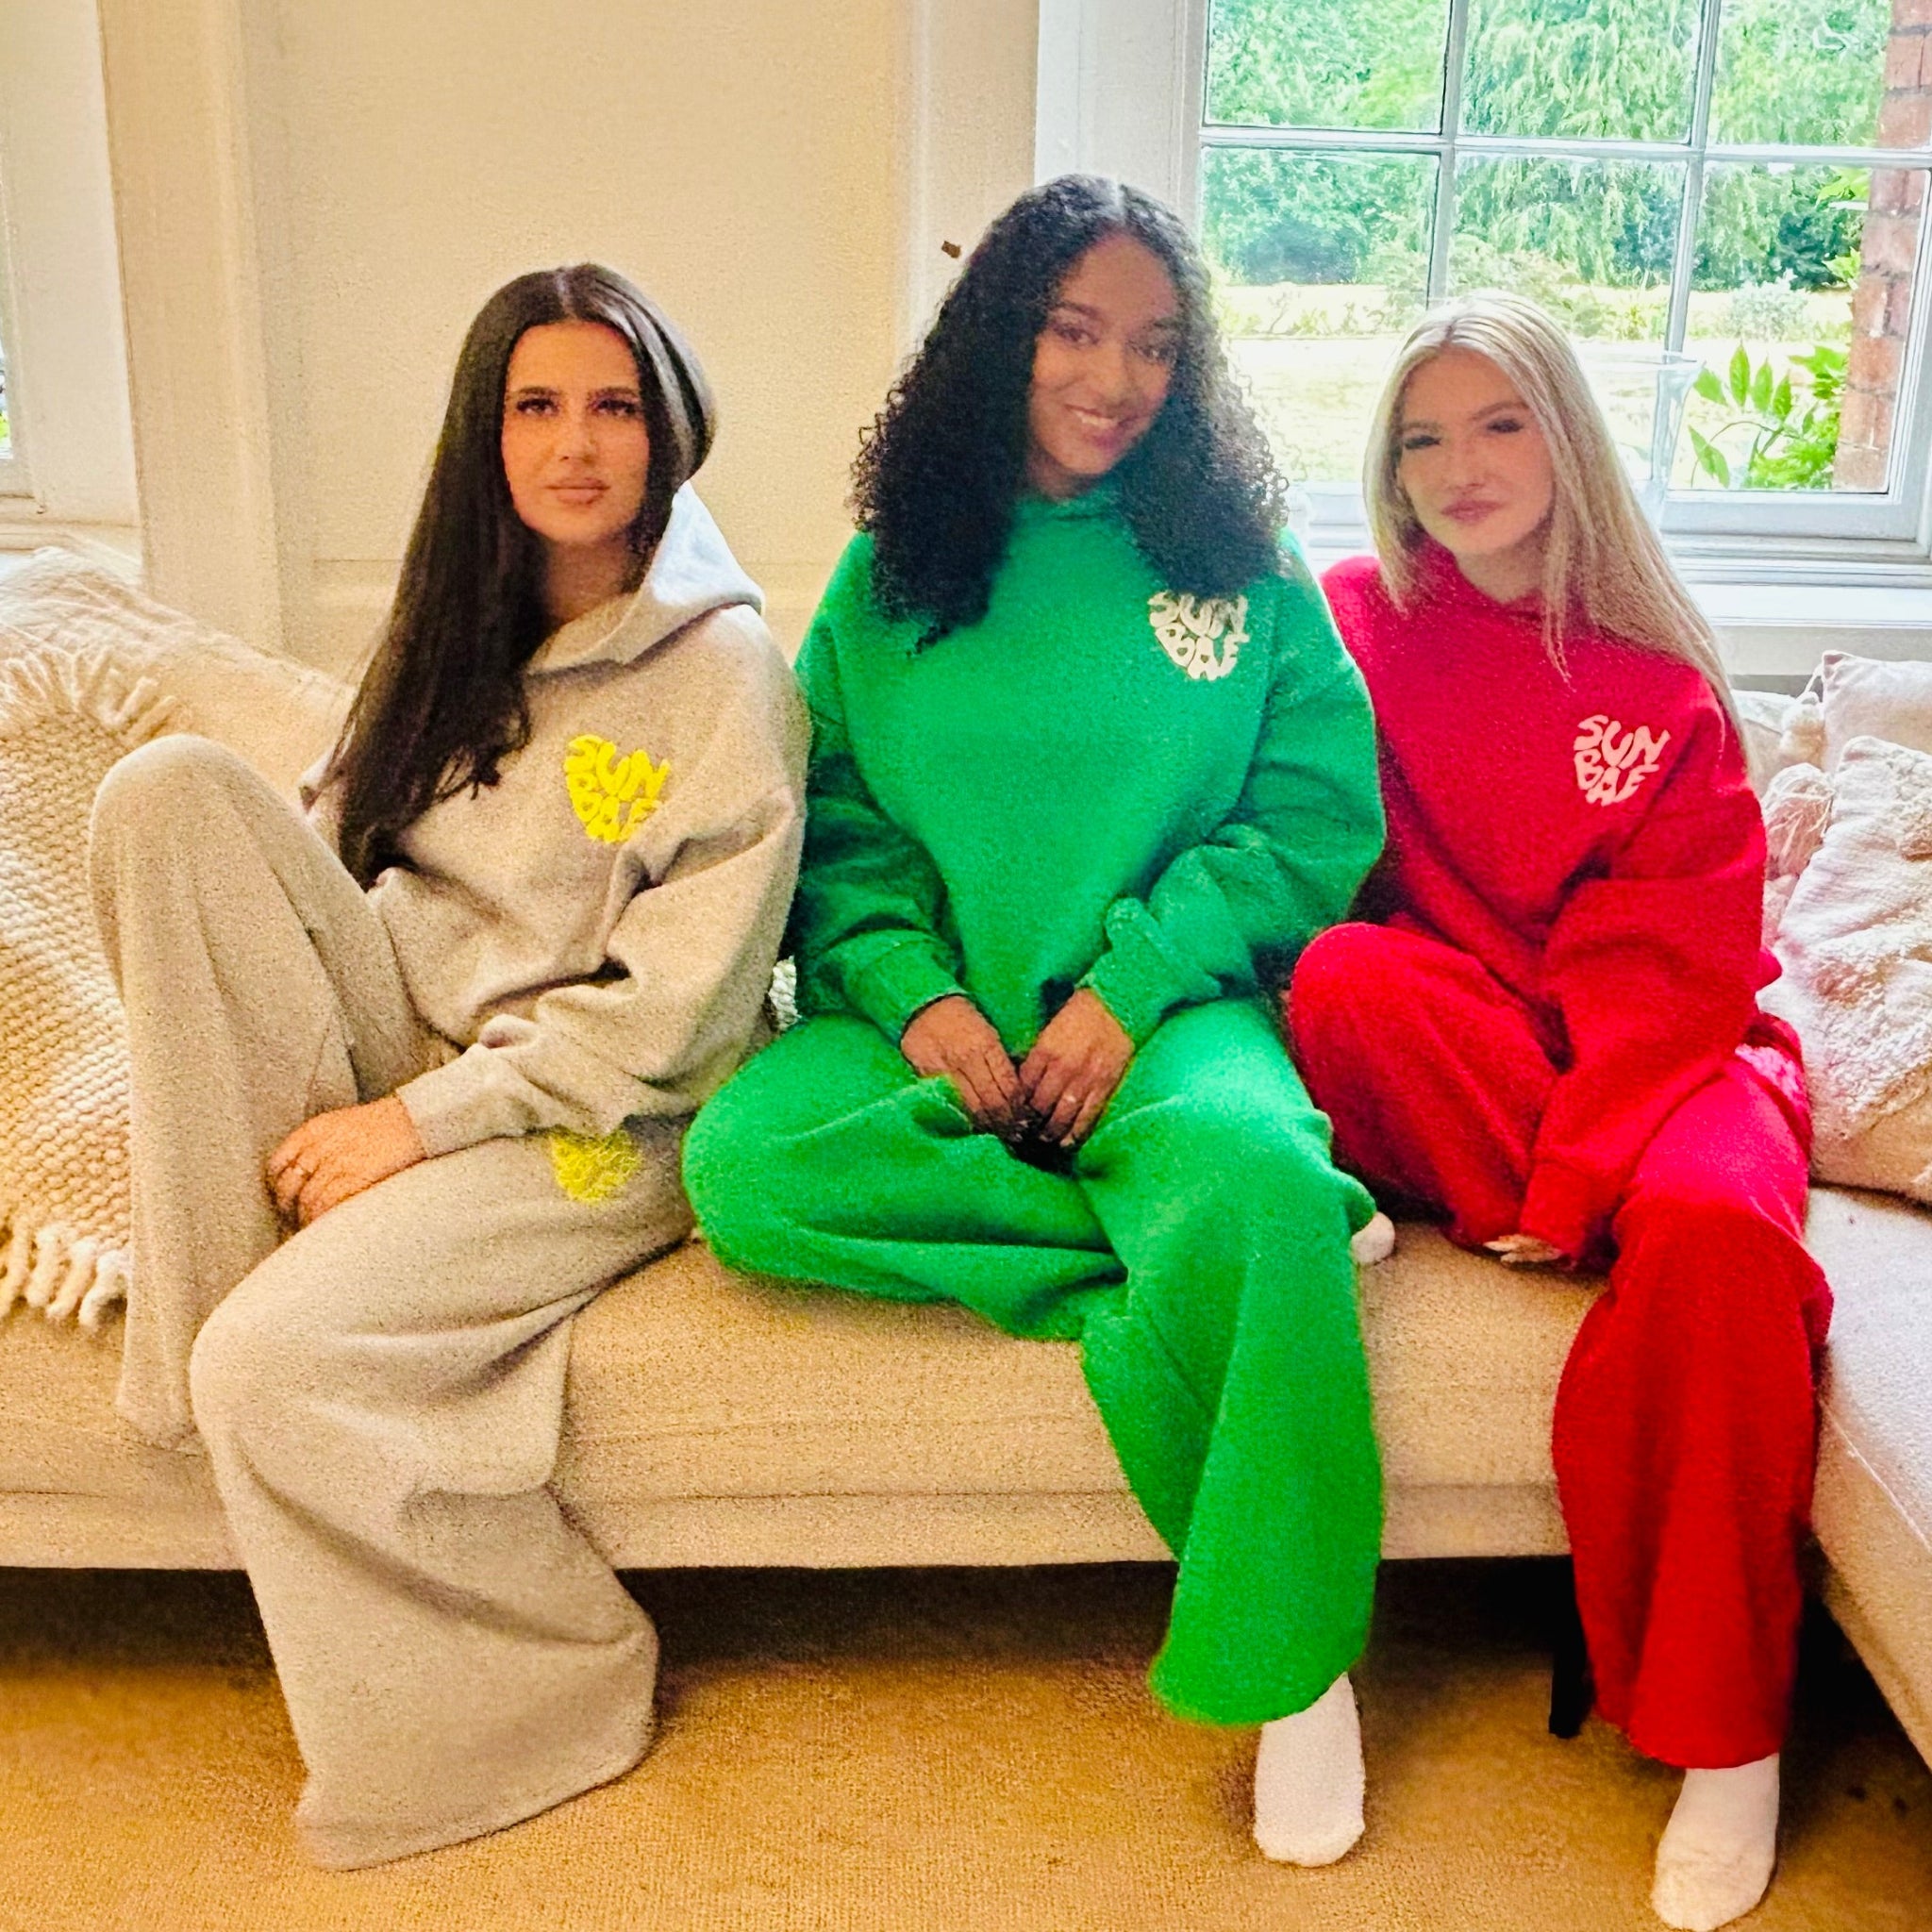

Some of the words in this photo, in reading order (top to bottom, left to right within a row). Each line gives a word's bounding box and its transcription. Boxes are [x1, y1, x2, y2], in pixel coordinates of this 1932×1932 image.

[1147, 590, 1248, 640] SUN
[1155, 623, 1250, 681] BAE
[563, 734, 671, 801] SUN
[1574, 714, 1671, 770] SUN
[1574, 748, 1660, 808] BAE
[566, 773, 661, 843] BAE
